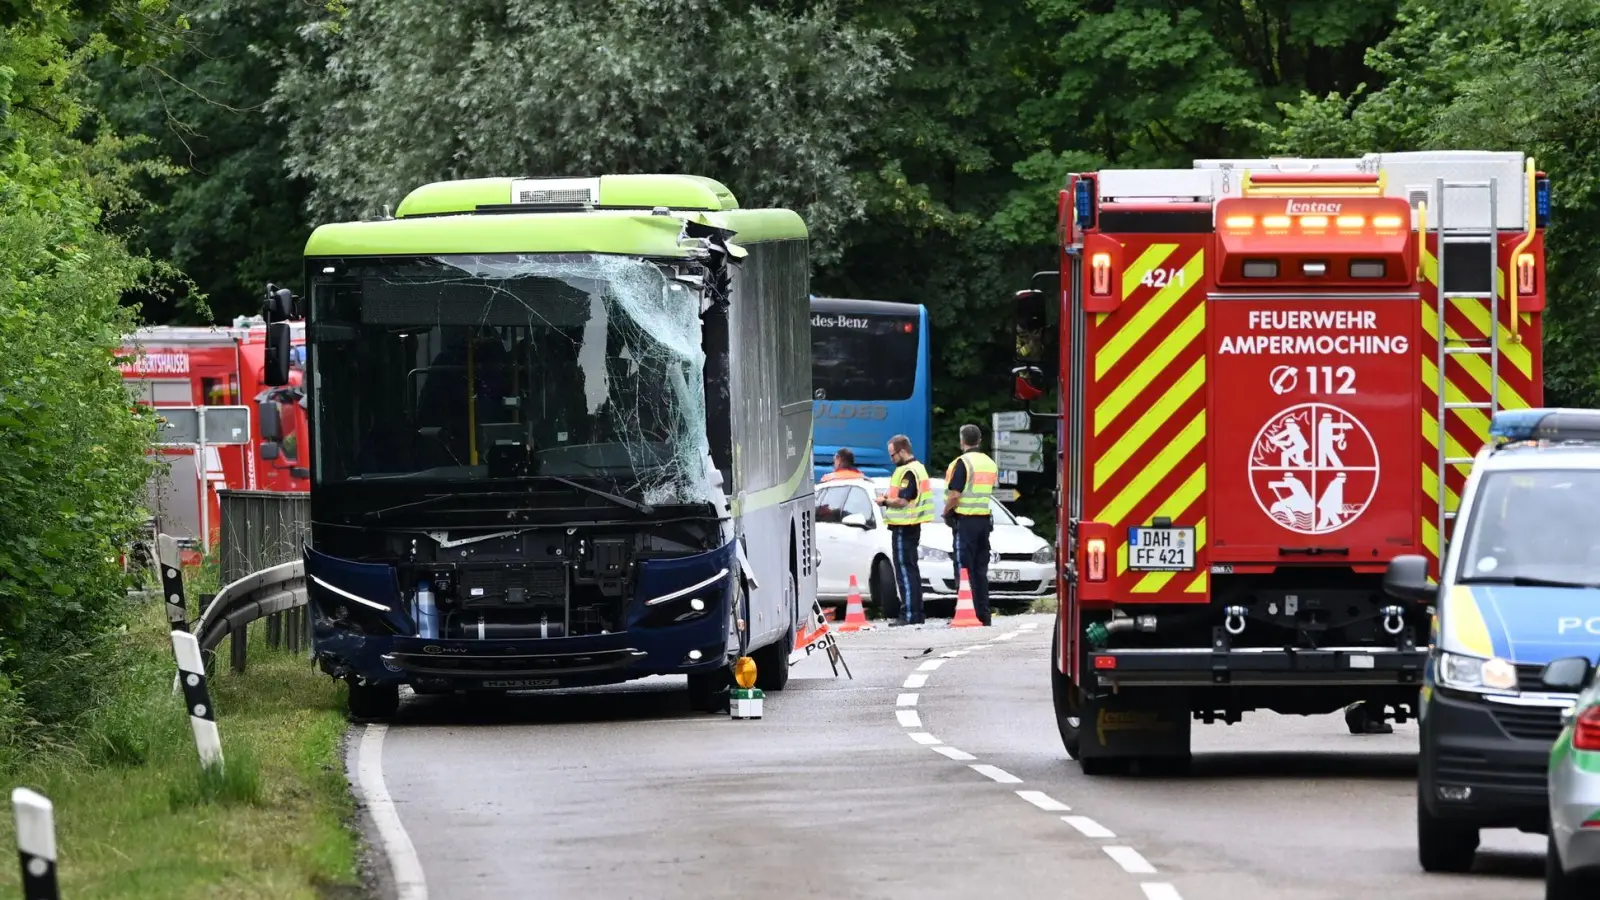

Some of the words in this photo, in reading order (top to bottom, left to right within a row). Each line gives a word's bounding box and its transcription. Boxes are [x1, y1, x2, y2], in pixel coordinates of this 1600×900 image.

[1141, 268, 1185, 288] 42/1
[811, 314, 869, 329] des-Benz
[1248, 311, 1377, 329] FEUERWEHR
[1218, 336, 1409, 354] AMPERMOCHING
[1305, 366, 1357, 395] 112
[1143, 531, 1171, 547] DAH
[1137, 548, 1155, 564] FF
[1159, 548, 1185, 564] 421
[1003, 571, 1019, 580] 773
